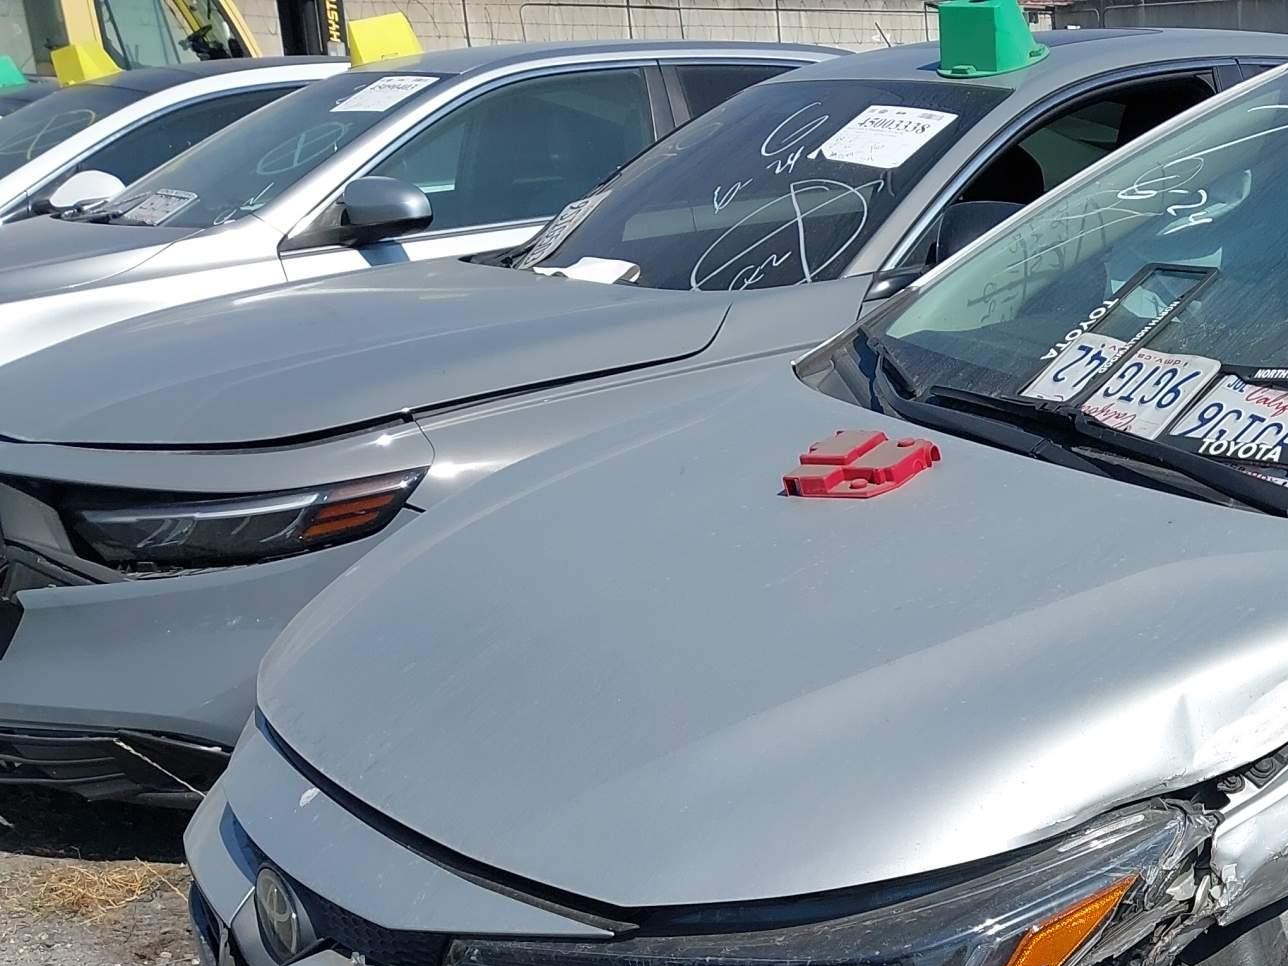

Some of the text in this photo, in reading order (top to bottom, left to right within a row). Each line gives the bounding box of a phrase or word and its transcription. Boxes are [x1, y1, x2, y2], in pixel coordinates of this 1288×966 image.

[858, 116, 931, 135] 45003338
[1040, 298, 1119, 360] TOYOTA
[1226, 377, 1246, 393] JUL
[1198, 438, 1283, 462] TOYOTA
